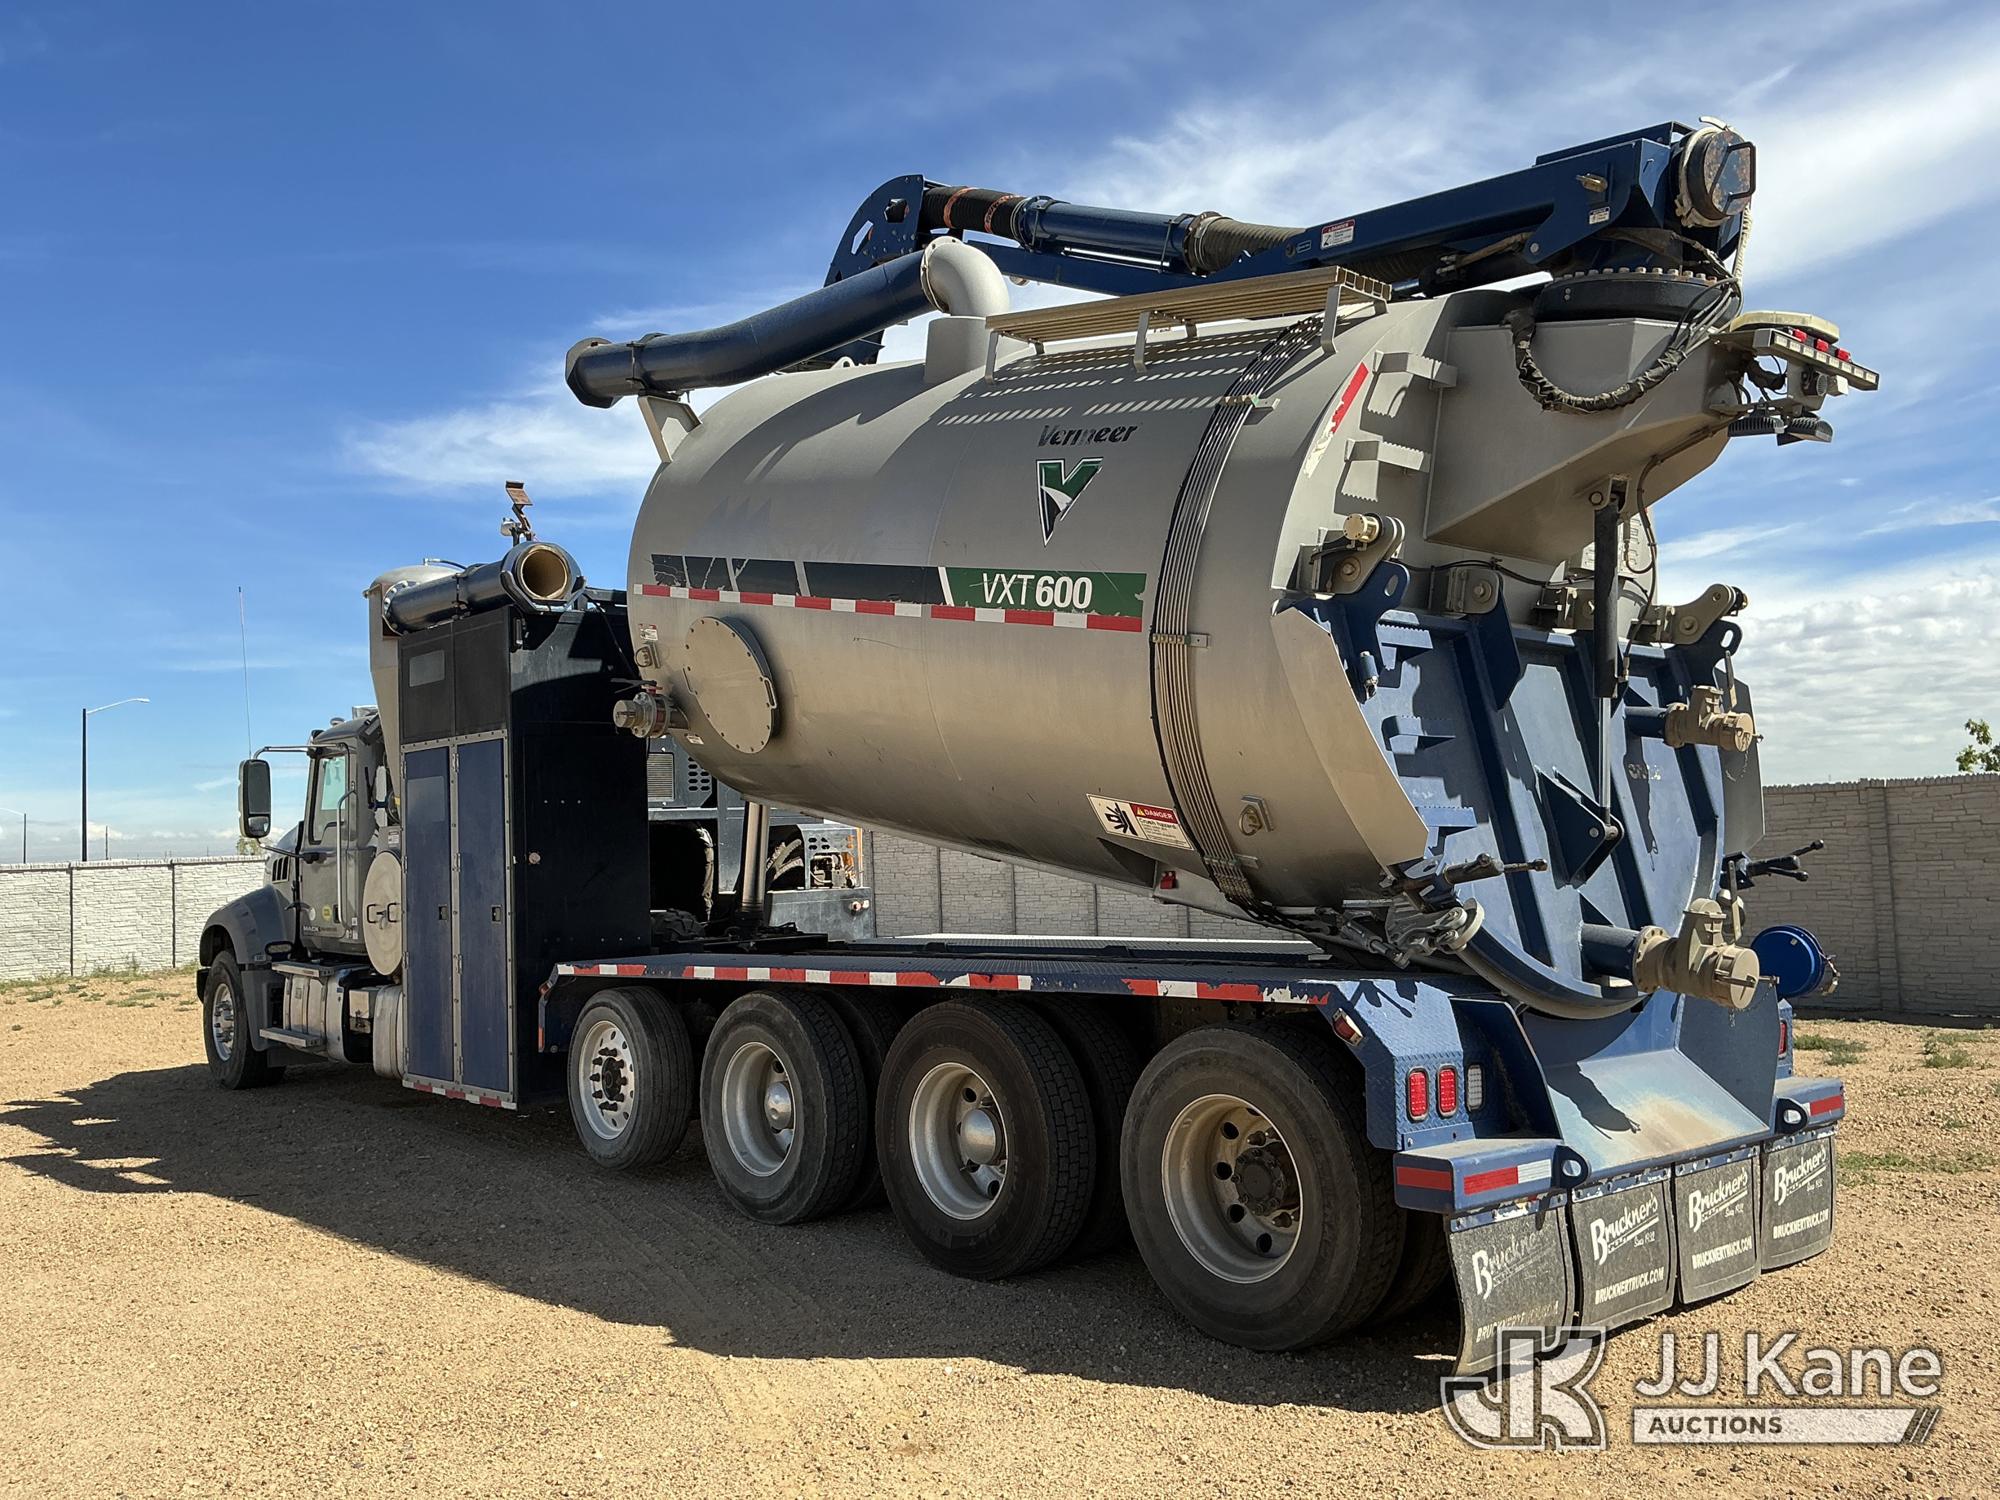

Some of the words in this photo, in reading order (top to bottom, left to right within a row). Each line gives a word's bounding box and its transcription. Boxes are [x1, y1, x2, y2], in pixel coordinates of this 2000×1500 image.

[1038, 424, 1138, 447] Vermeer
[1144, 808, 1174, 820] DANGER
[1688, 1166, 1748, 1233] Bruckner's
[1590, 1191, 1659, 1266] Bruckner's
[1773, 1208, 1829, 1239] BRUCKNERTRUCK.COM
[1692, 1235, 1752, 1270] BRUCKNERTRUCK.COM
[1595, 1266, 1665, 1305] BRUCKNERTRUCK.COM
